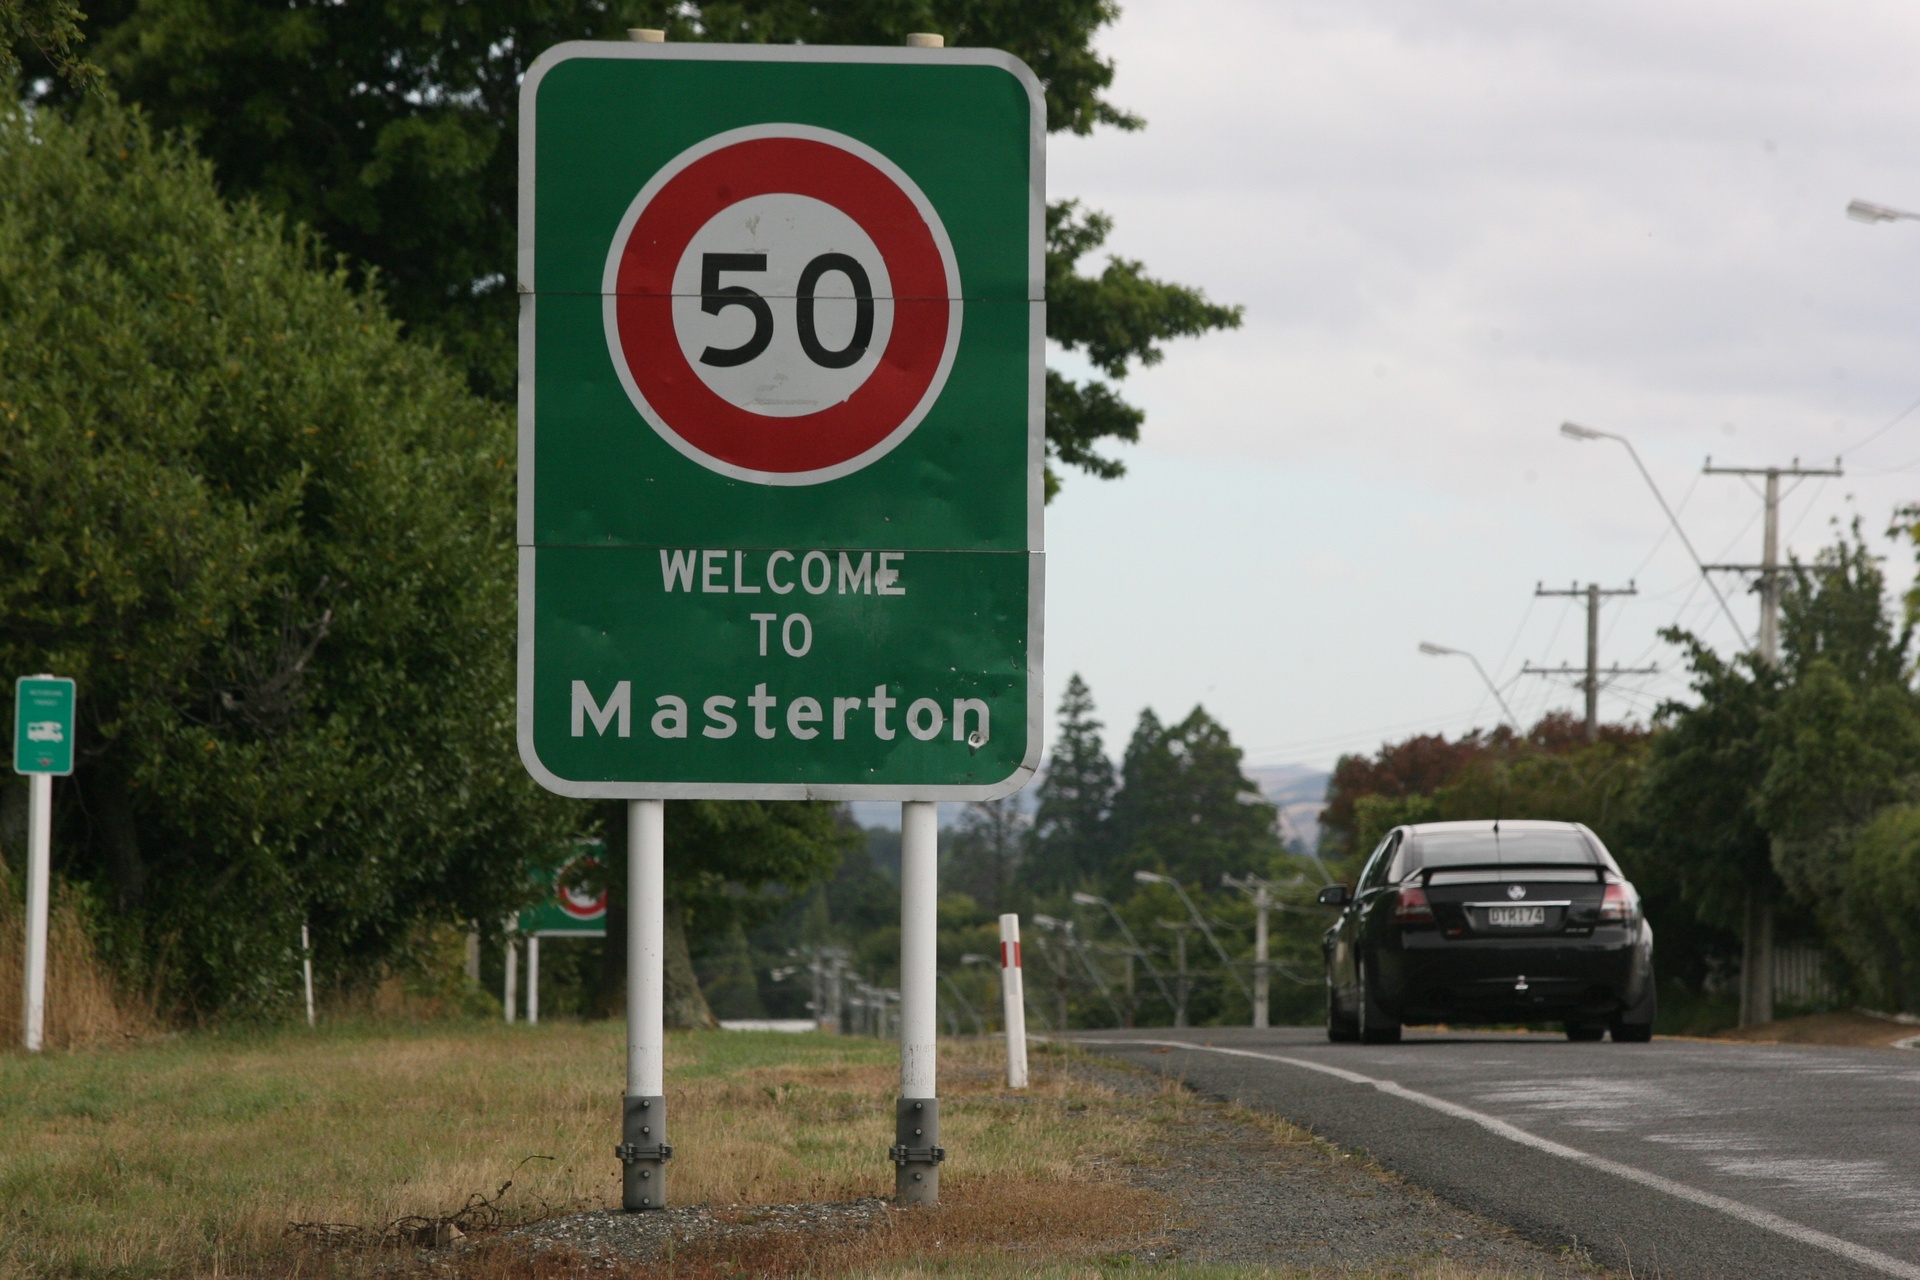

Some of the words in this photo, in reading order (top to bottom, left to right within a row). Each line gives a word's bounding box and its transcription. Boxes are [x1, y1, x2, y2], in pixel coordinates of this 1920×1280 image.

[699, 252, 875, 369] 50
[659, 549, 906, 595] WELCOME
[750, 613, 813, 657] TO
[571, 680, 990, 741] Masterton
